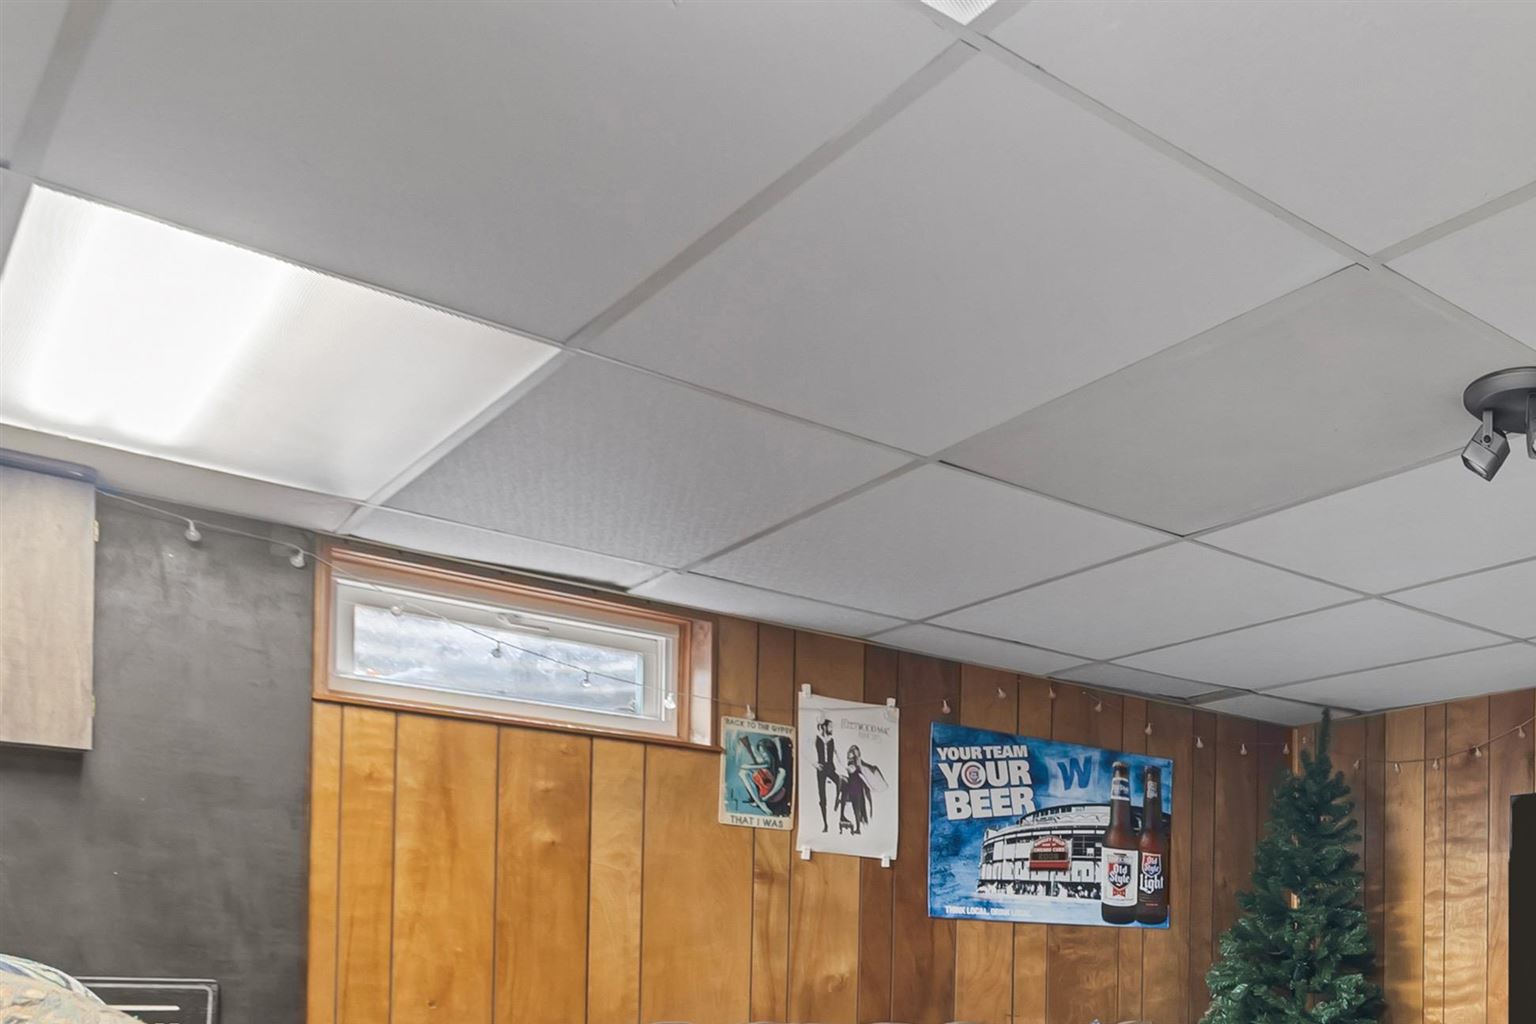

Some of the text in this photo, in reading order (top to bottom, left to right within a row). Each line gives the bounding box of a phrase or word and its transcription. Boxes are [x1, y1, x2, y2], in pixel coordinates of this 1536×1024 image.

[747, 721, 757, 729] TO
[937, 745, 1029, 760] YOUR TEAM
[938, 760, 1032, 790] YOUR
[1056, 756, 1092, 791] W
[944, 786, 1036, 820] BEER
[730, 815, 753, 825] THAT
[763, 817, 784, 828] WAS
[1113, 863, 1128, 876] Old
[1109, 870, 1130, 887] Style
[1139, 873, 1164, 894] Light
